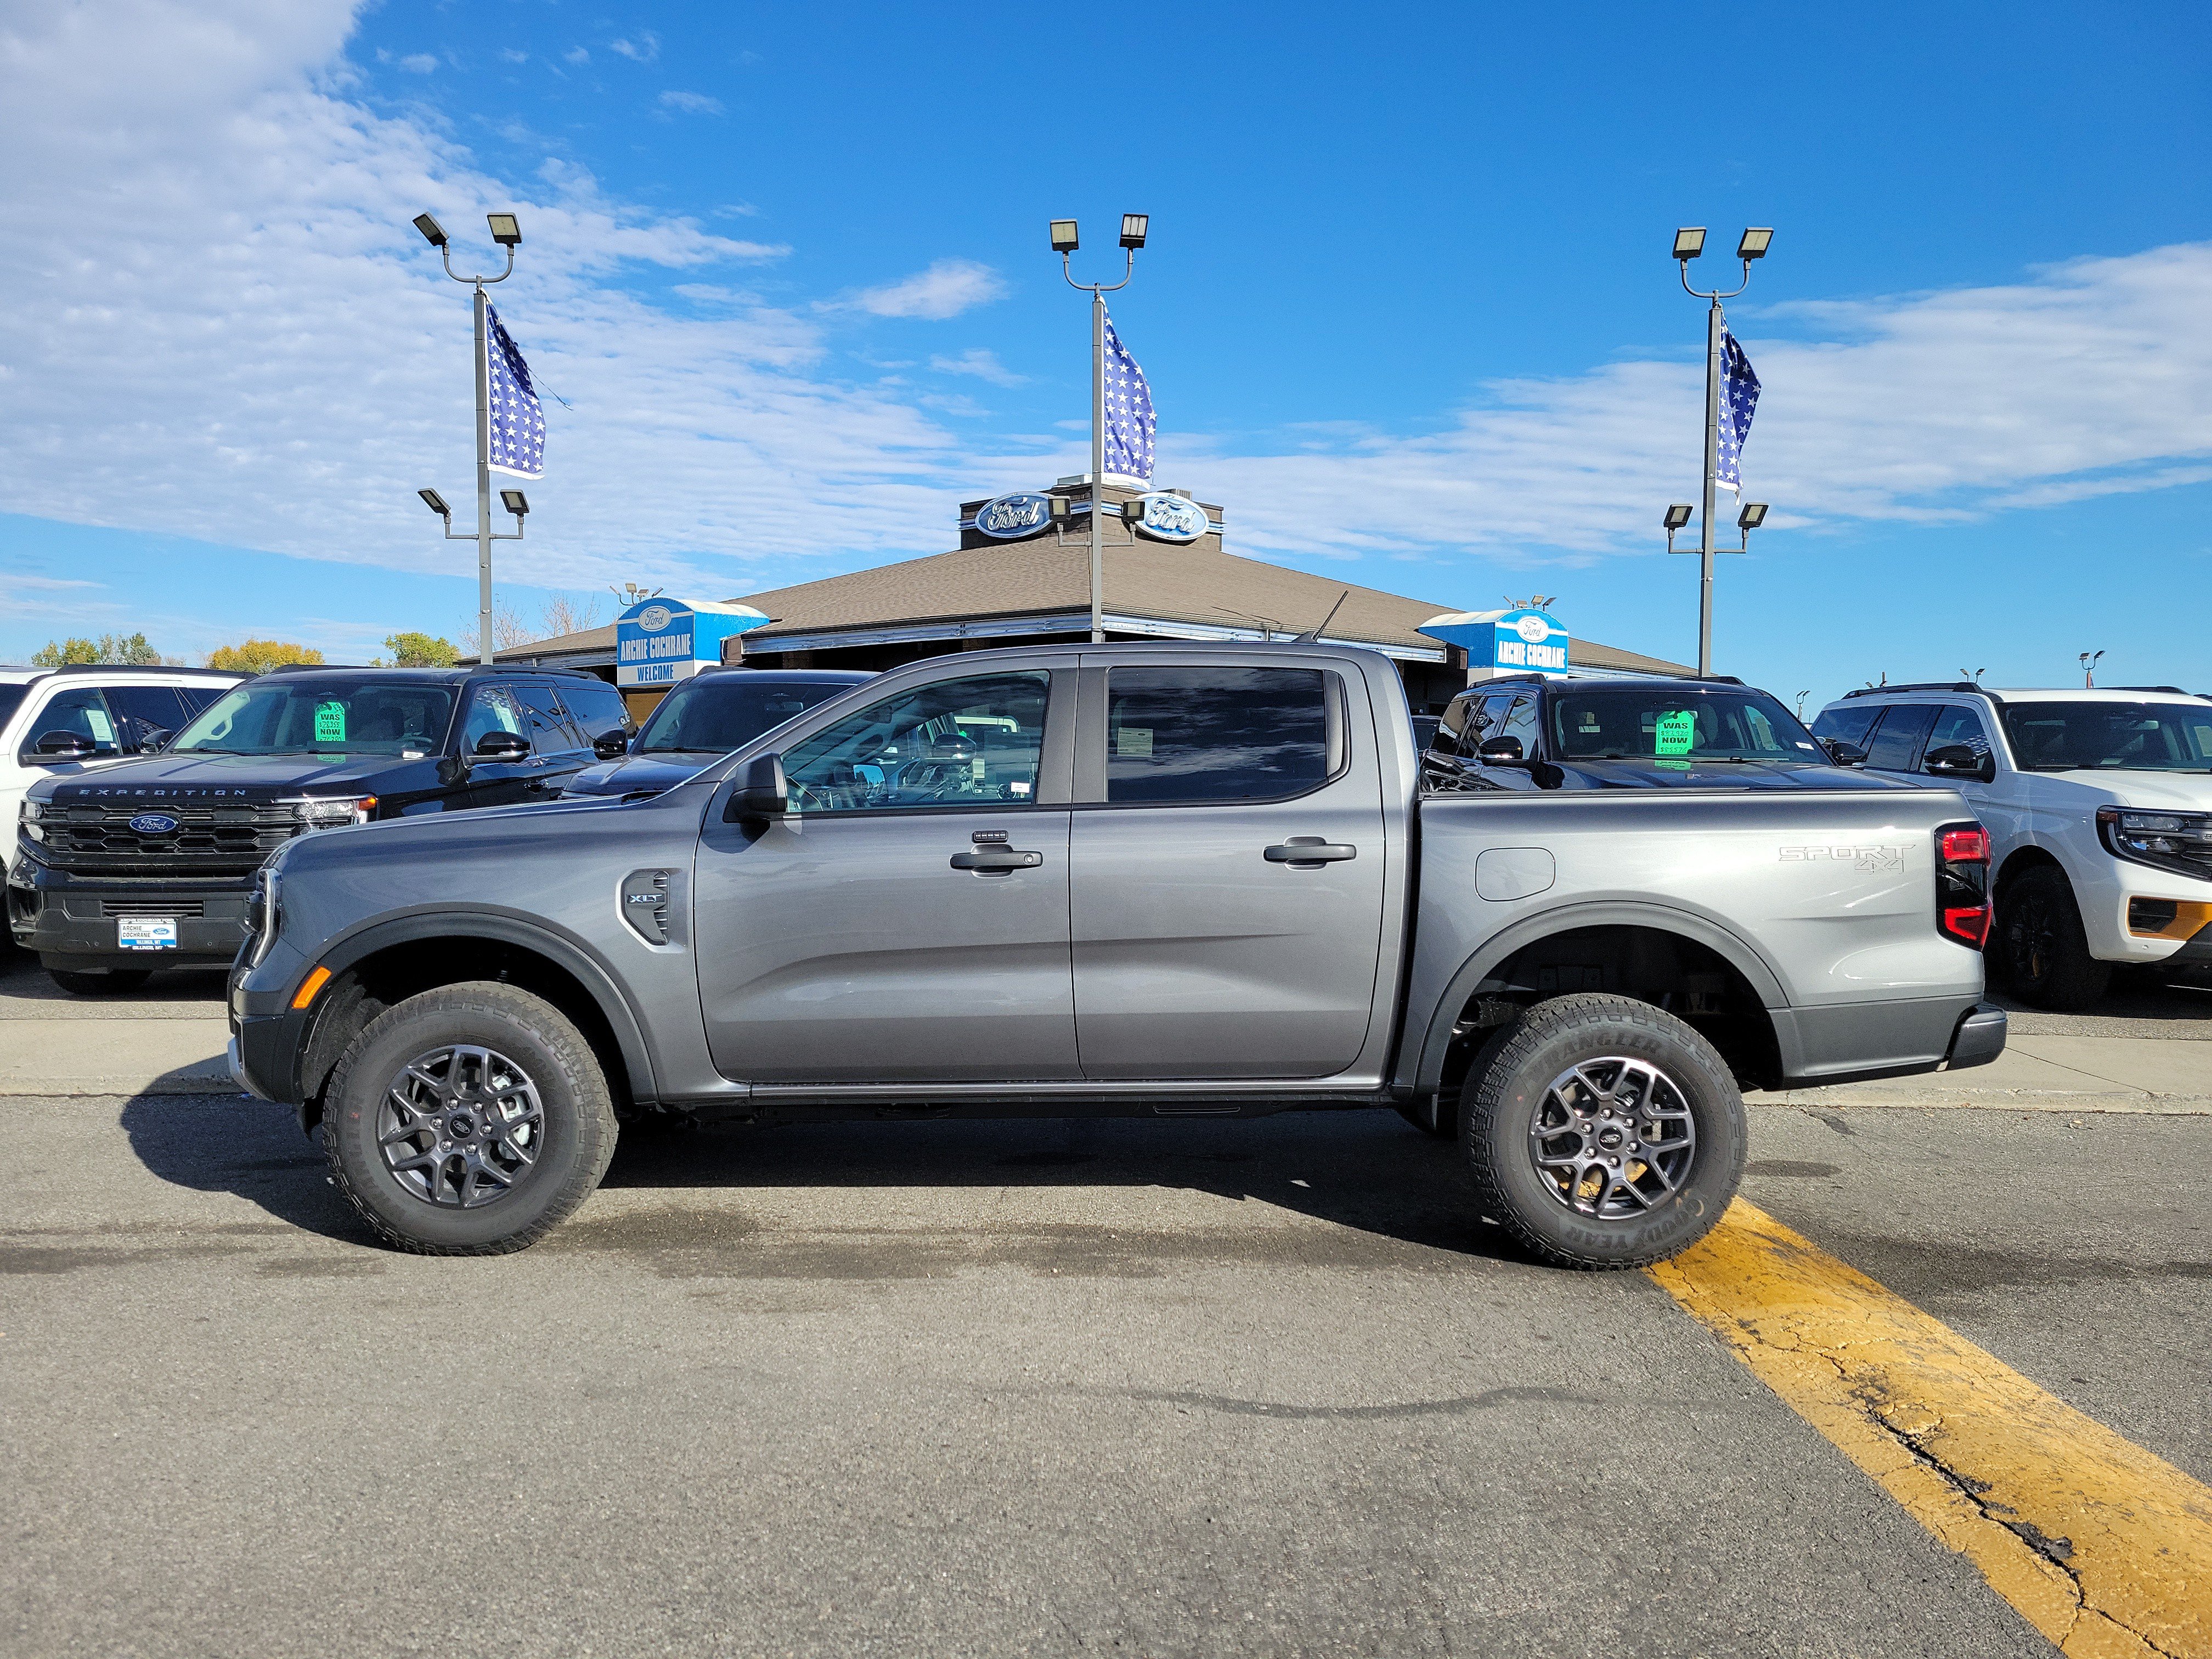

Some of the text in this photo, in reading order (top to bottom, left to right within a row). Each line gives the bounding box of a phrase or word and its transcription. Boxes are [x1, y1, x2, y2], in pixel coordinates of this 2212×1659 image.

[988, 496, 1041, 531] Ford
[1148, 498, 1196, 533] Ford
[645, 610, 664, 626] Ford
[1523, 620, 1542, 636] Ford
[620, 633, 691, 662] ARCHIE COCHRANE
[1497, 640, 1565, 669] ARCHIE COCHRANE
[637, 664, 674, 682] WELCOME
[1779, 844, 1916, 861] SPORT
[630, 894, 663, 903] XLT
[1526, 1031, 1663, 1084] WRANGLER
